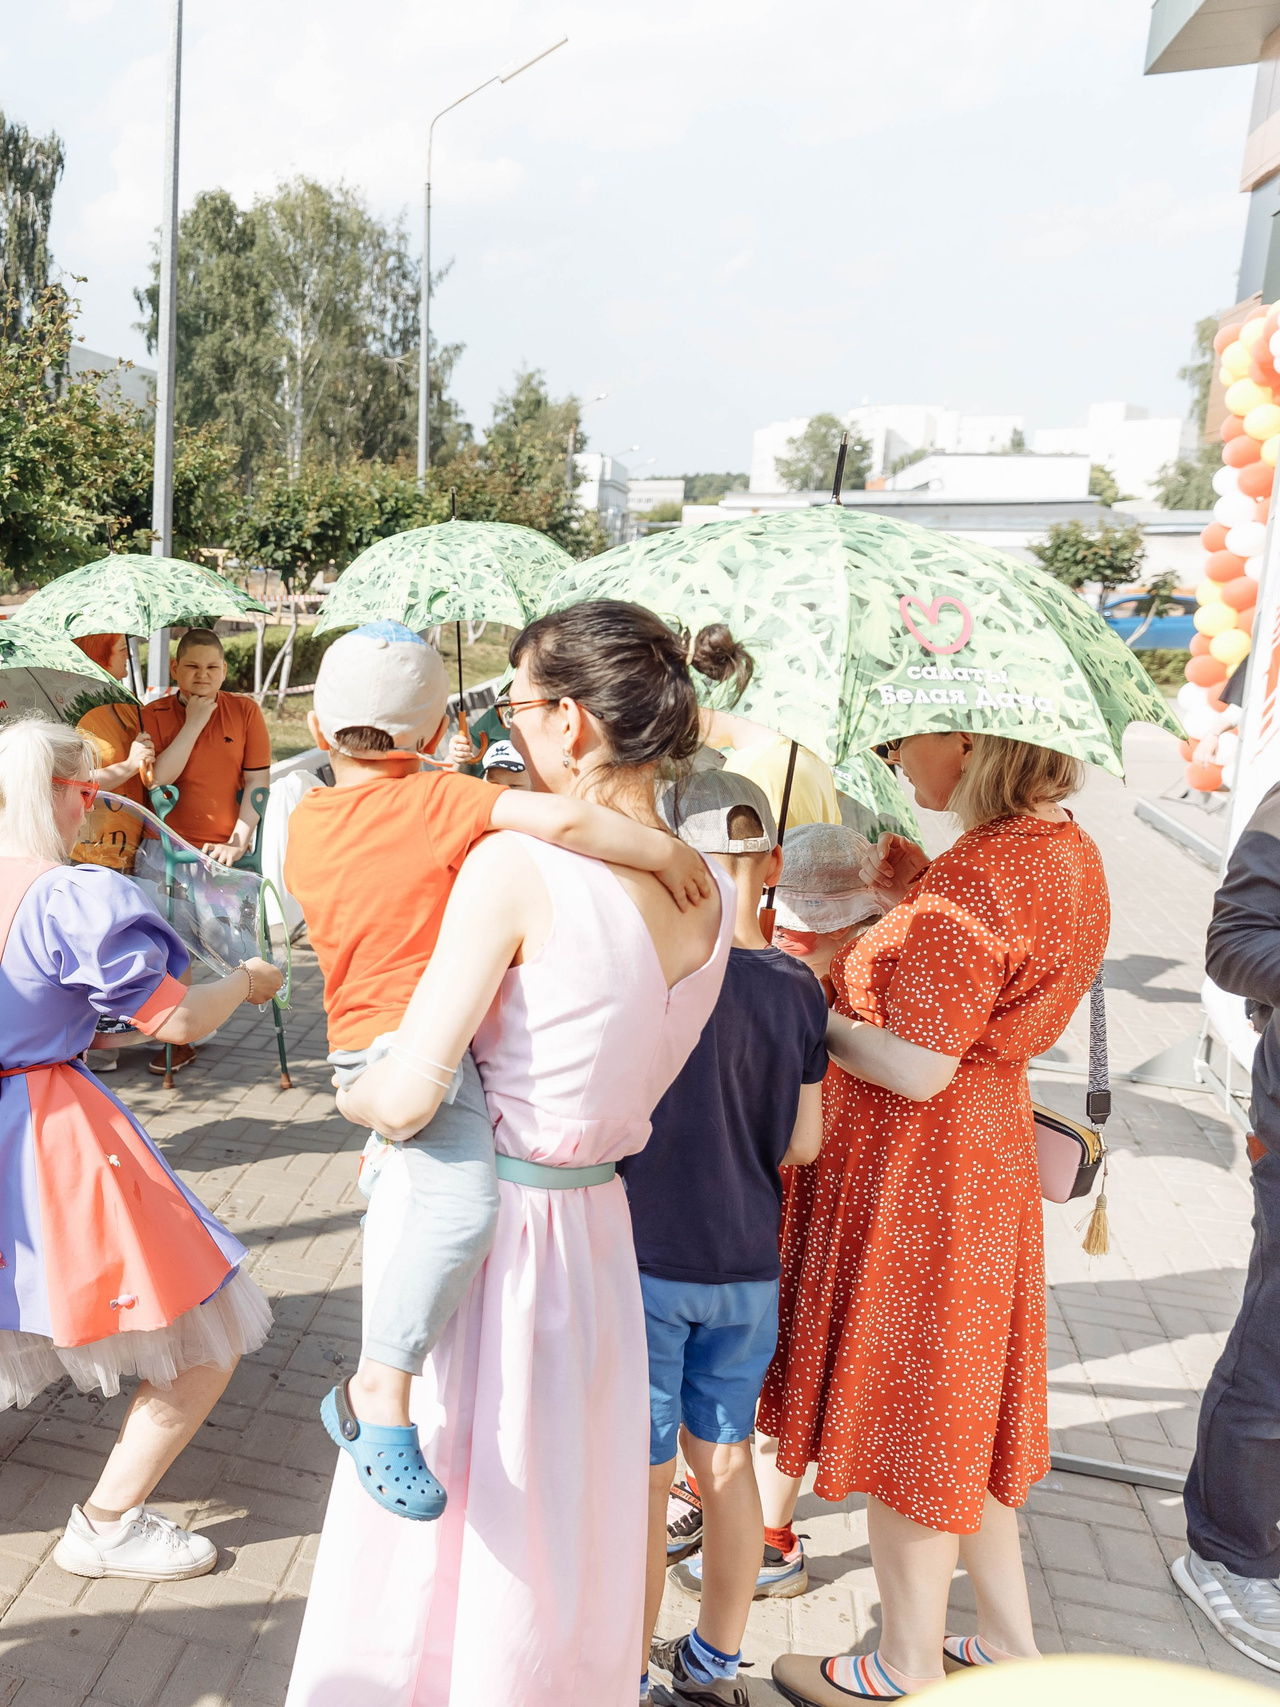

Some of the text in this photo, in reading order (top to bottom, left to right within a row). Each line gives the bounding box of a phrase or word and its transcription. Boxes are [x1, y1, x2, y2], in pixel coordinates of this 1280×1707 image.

[907, 666, 1009, 684] салаты
[878, 685, 1054, 712] Белая Дача
